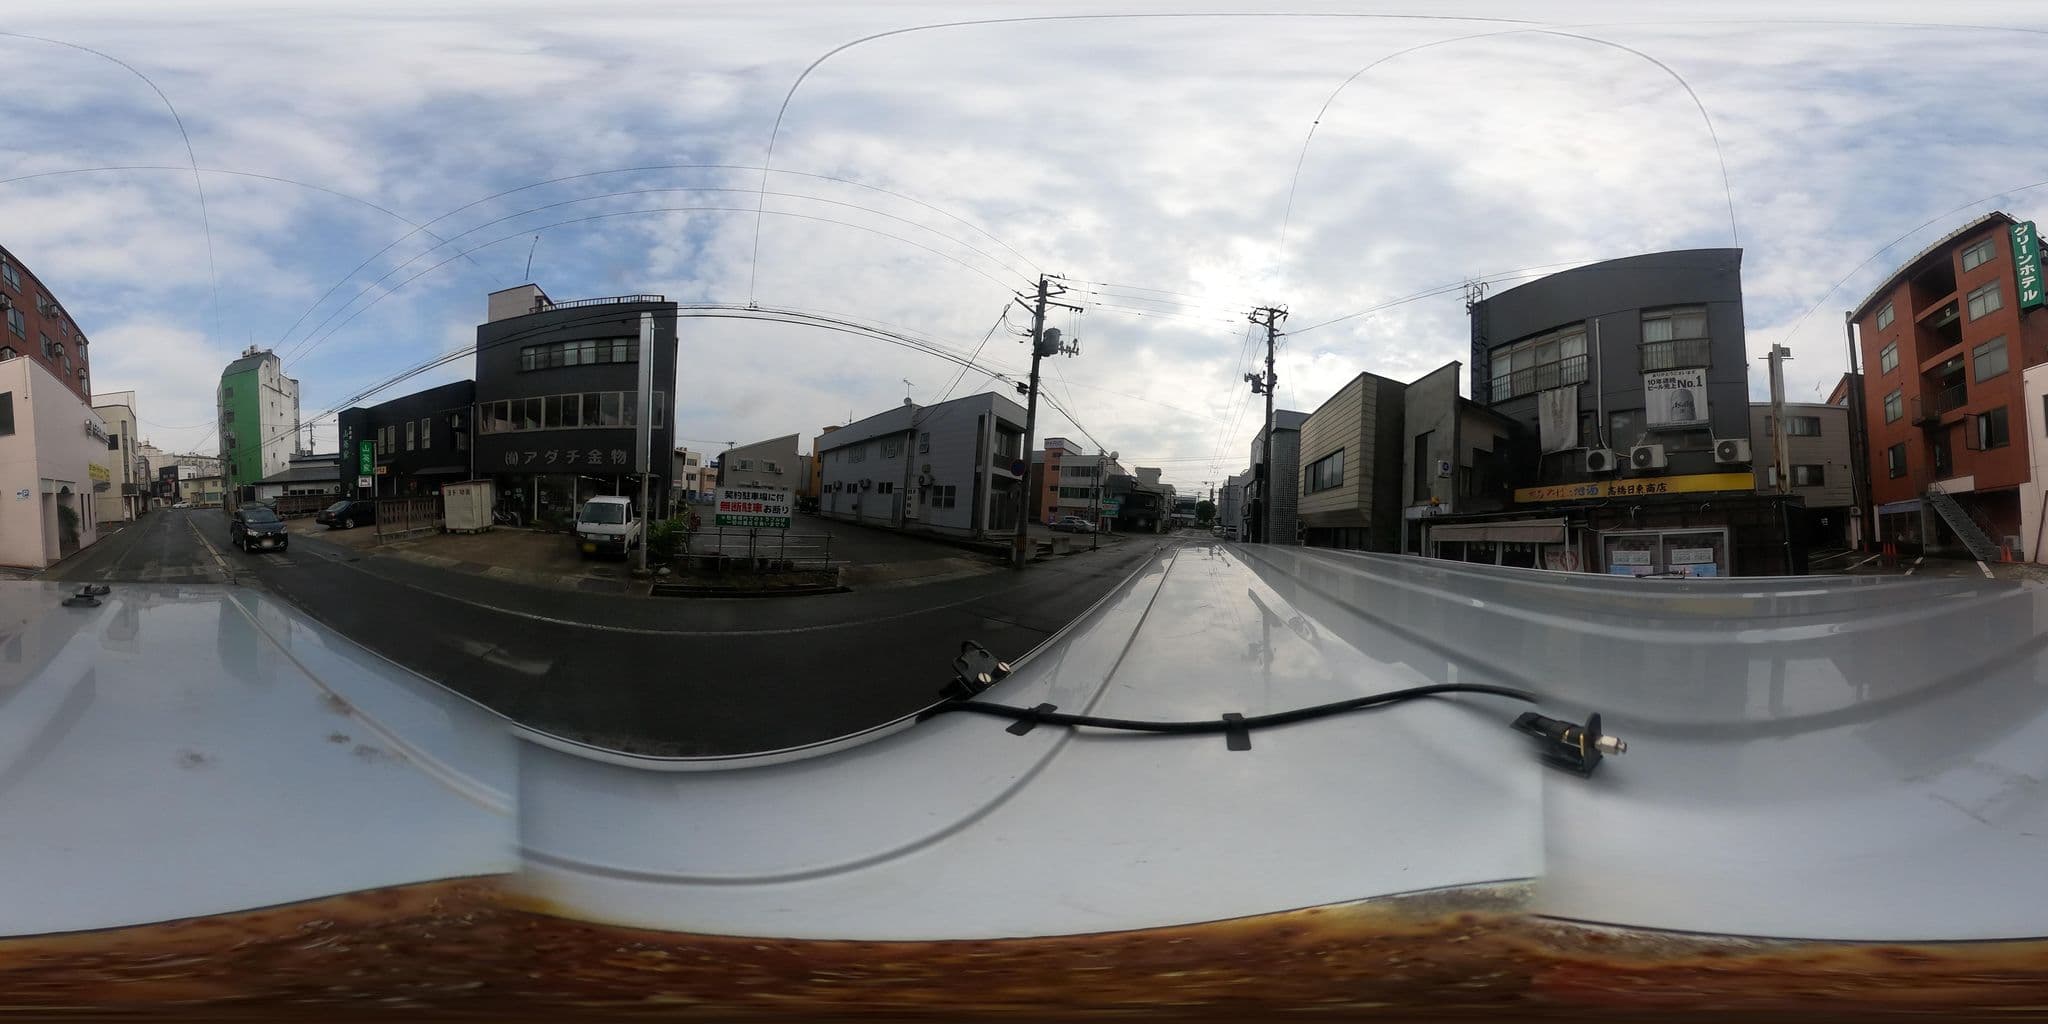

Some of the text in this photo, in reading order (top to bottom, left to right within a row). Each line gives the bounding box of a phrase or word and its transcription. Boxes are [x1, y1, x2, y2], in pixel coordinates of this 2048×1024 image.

[2014, 224, 2038, 302] グリーンホテル
[1677, 375, 1703, 389] No.1
[720, 501, 789, 514] 無断駐車お断り
